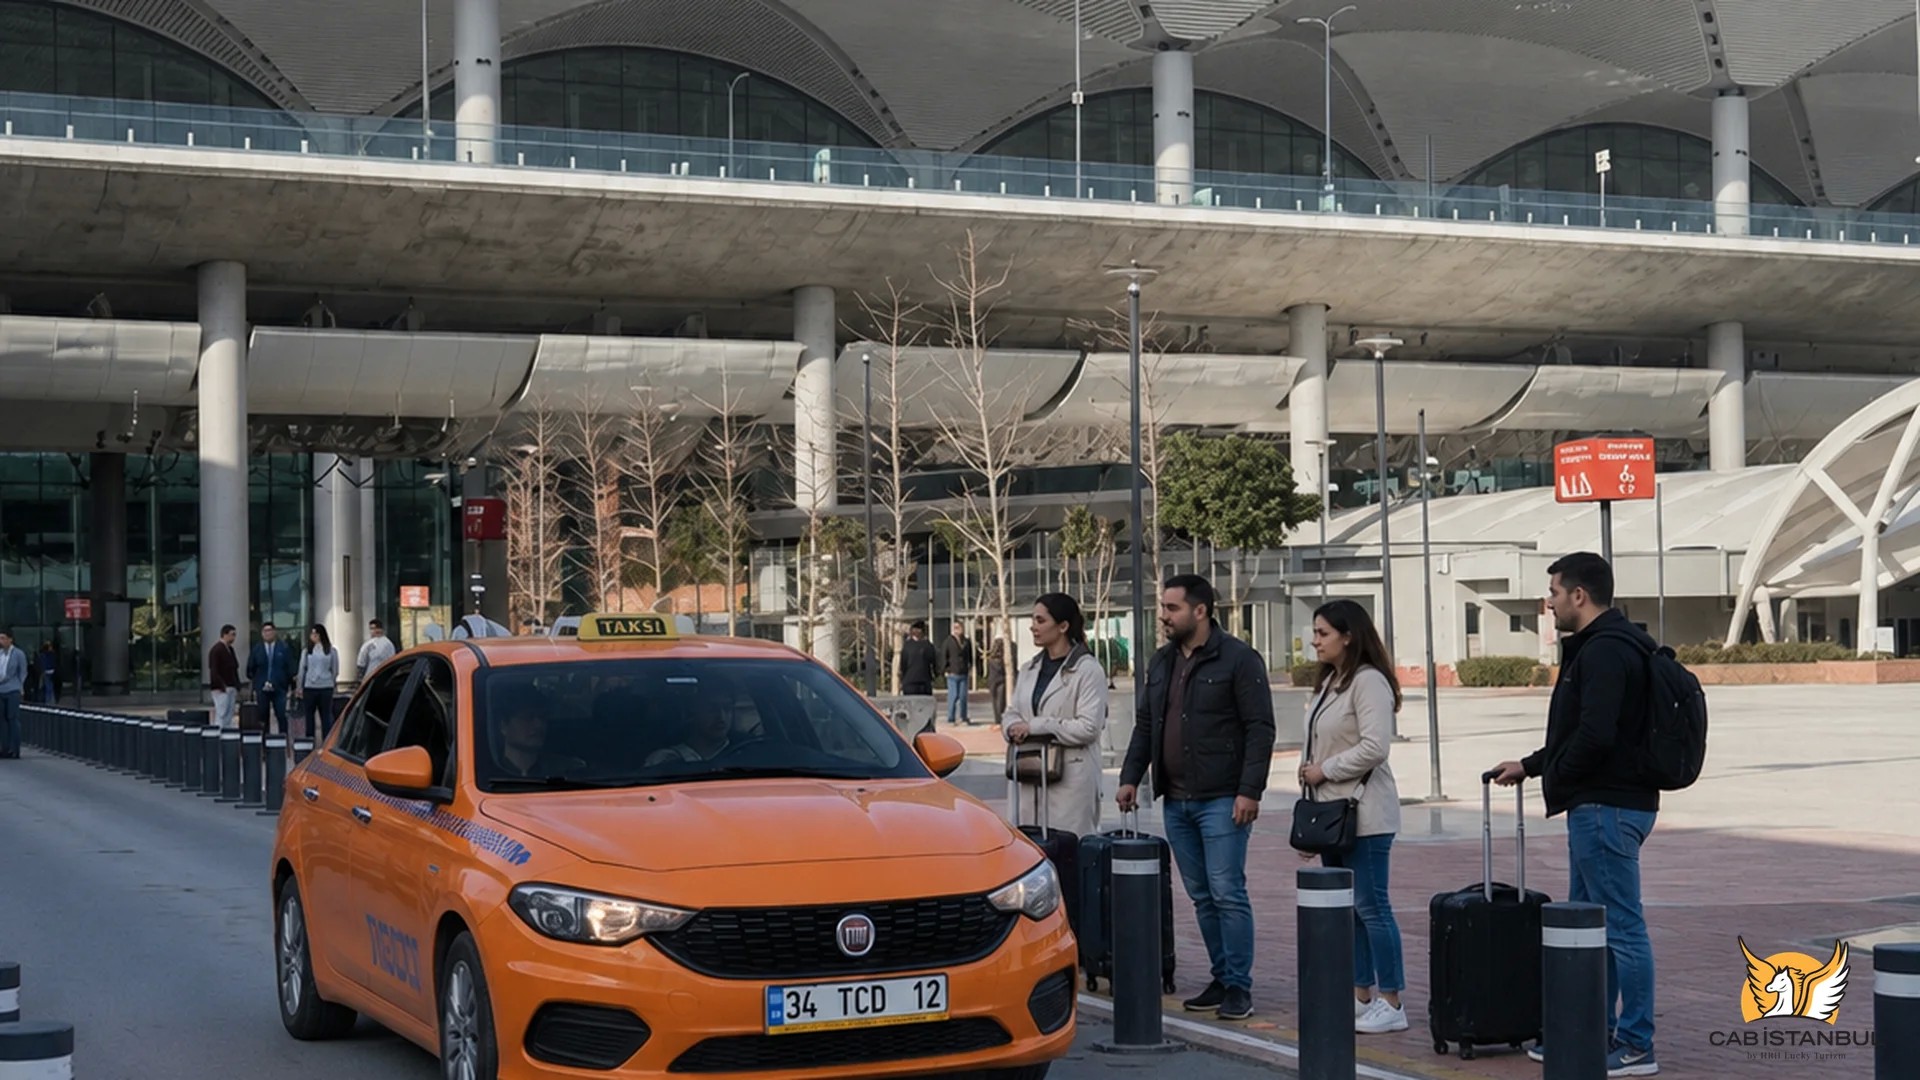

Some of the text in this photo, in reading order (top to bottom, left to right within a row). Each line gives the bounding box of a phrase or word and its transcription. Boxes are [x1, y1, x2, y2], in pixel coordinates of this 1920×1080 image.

[785, 979, 941, 1019] 34 TCD 12
